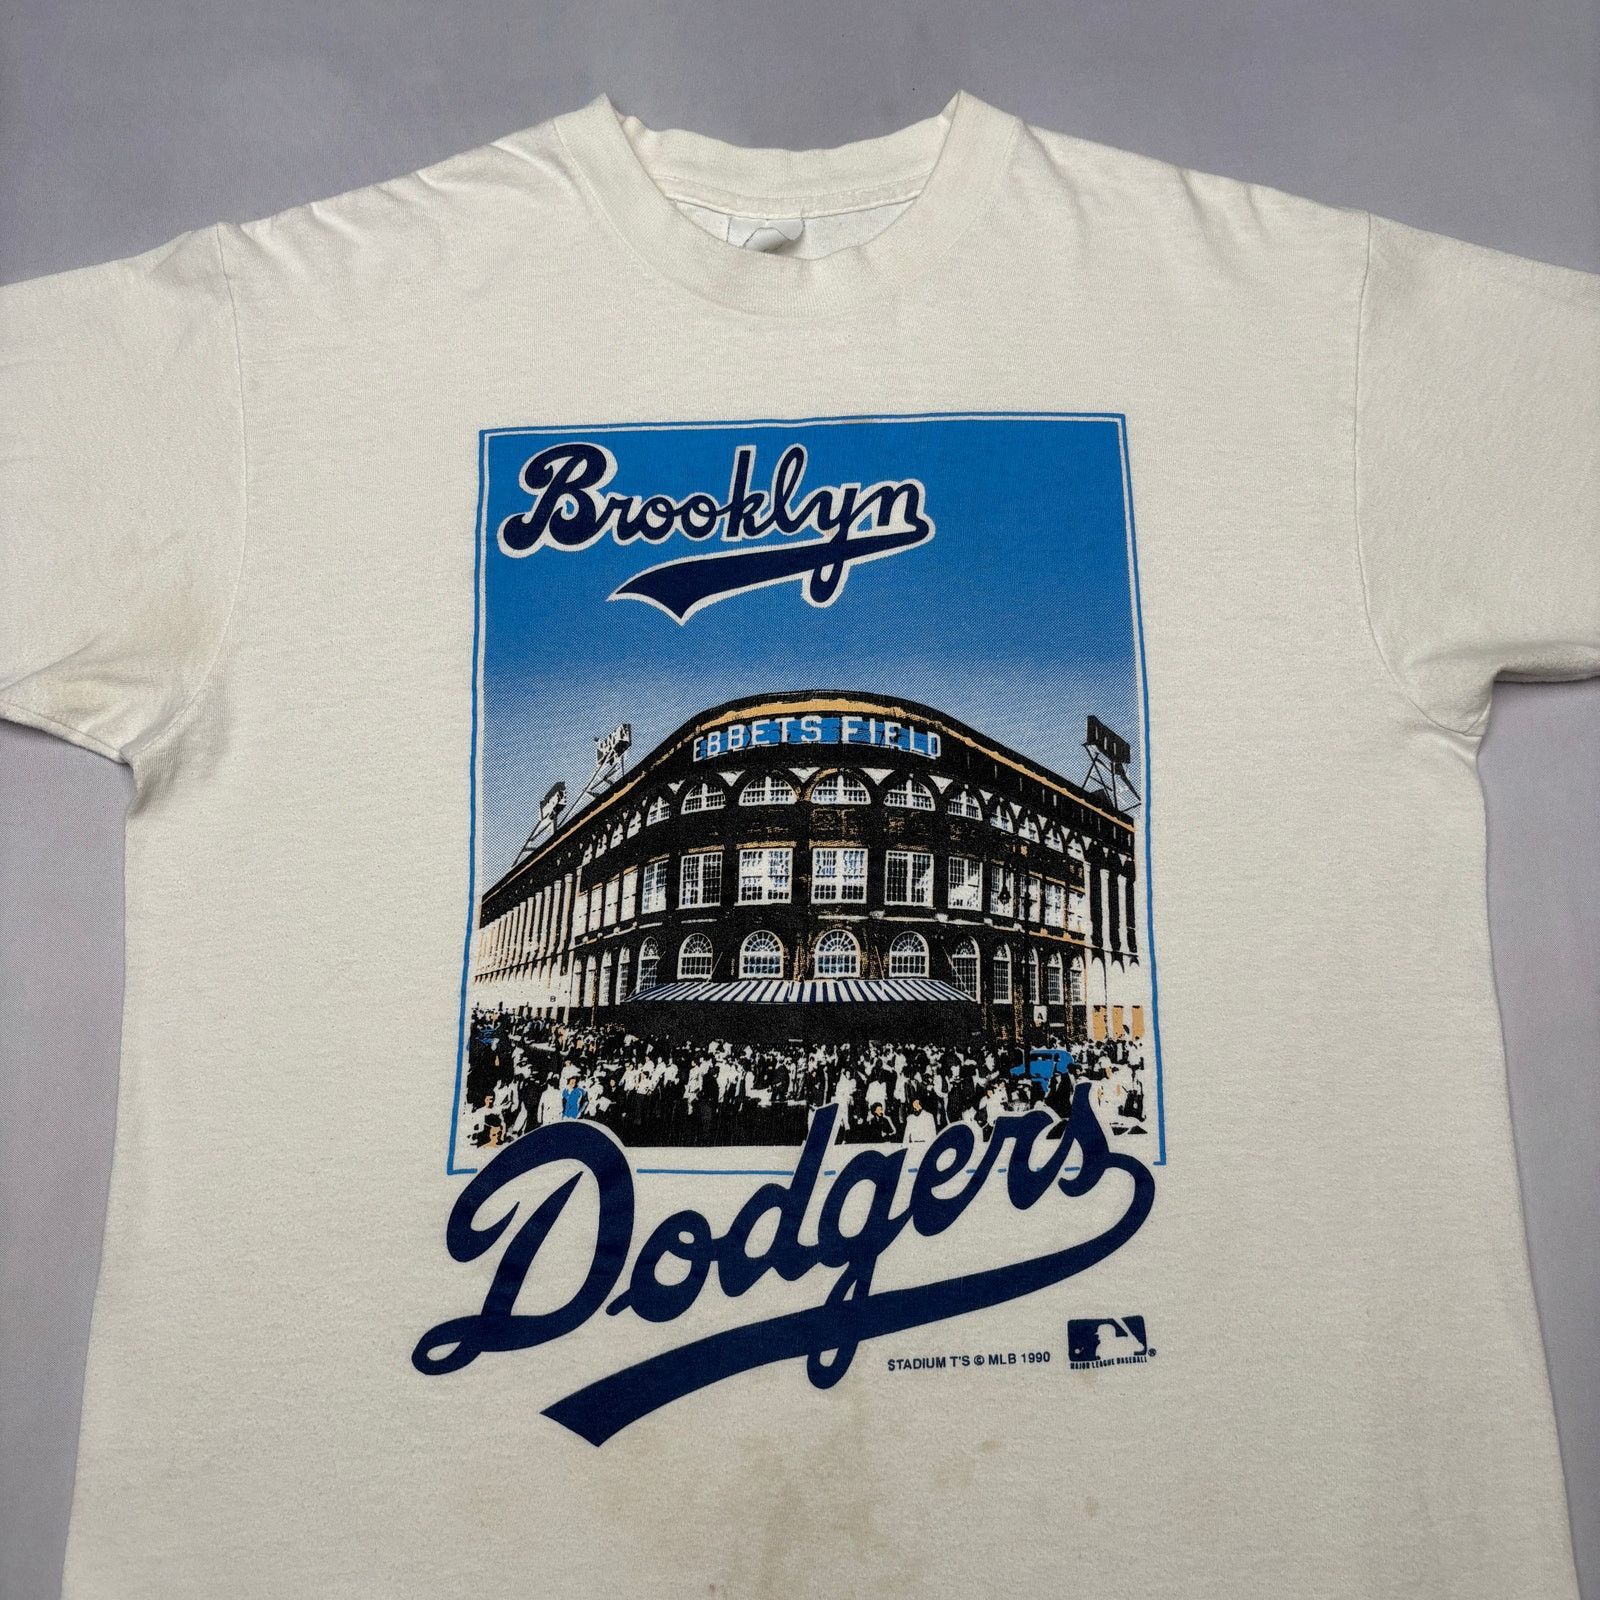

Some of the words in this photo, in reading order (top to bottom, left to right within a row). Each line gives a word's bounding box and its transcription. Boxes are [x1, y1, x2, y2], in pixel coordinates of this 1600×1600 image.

[497, 442, 936, 626] Brooklyn
[693, 716, 823, 762] EBBETS
[841, 716, 941, 759] FIELD
[412, 1083, 1155, 1447] Dodgers
[887, 1357, 946, 1371] STADIUM
[950, 1355, 970, 1367] T'S
[988, 1353, 1017, 1365] MLB
[1021, 1351, 1050, 1363] 1990
[1070, 1362, 1090, 1370] MAJOR
